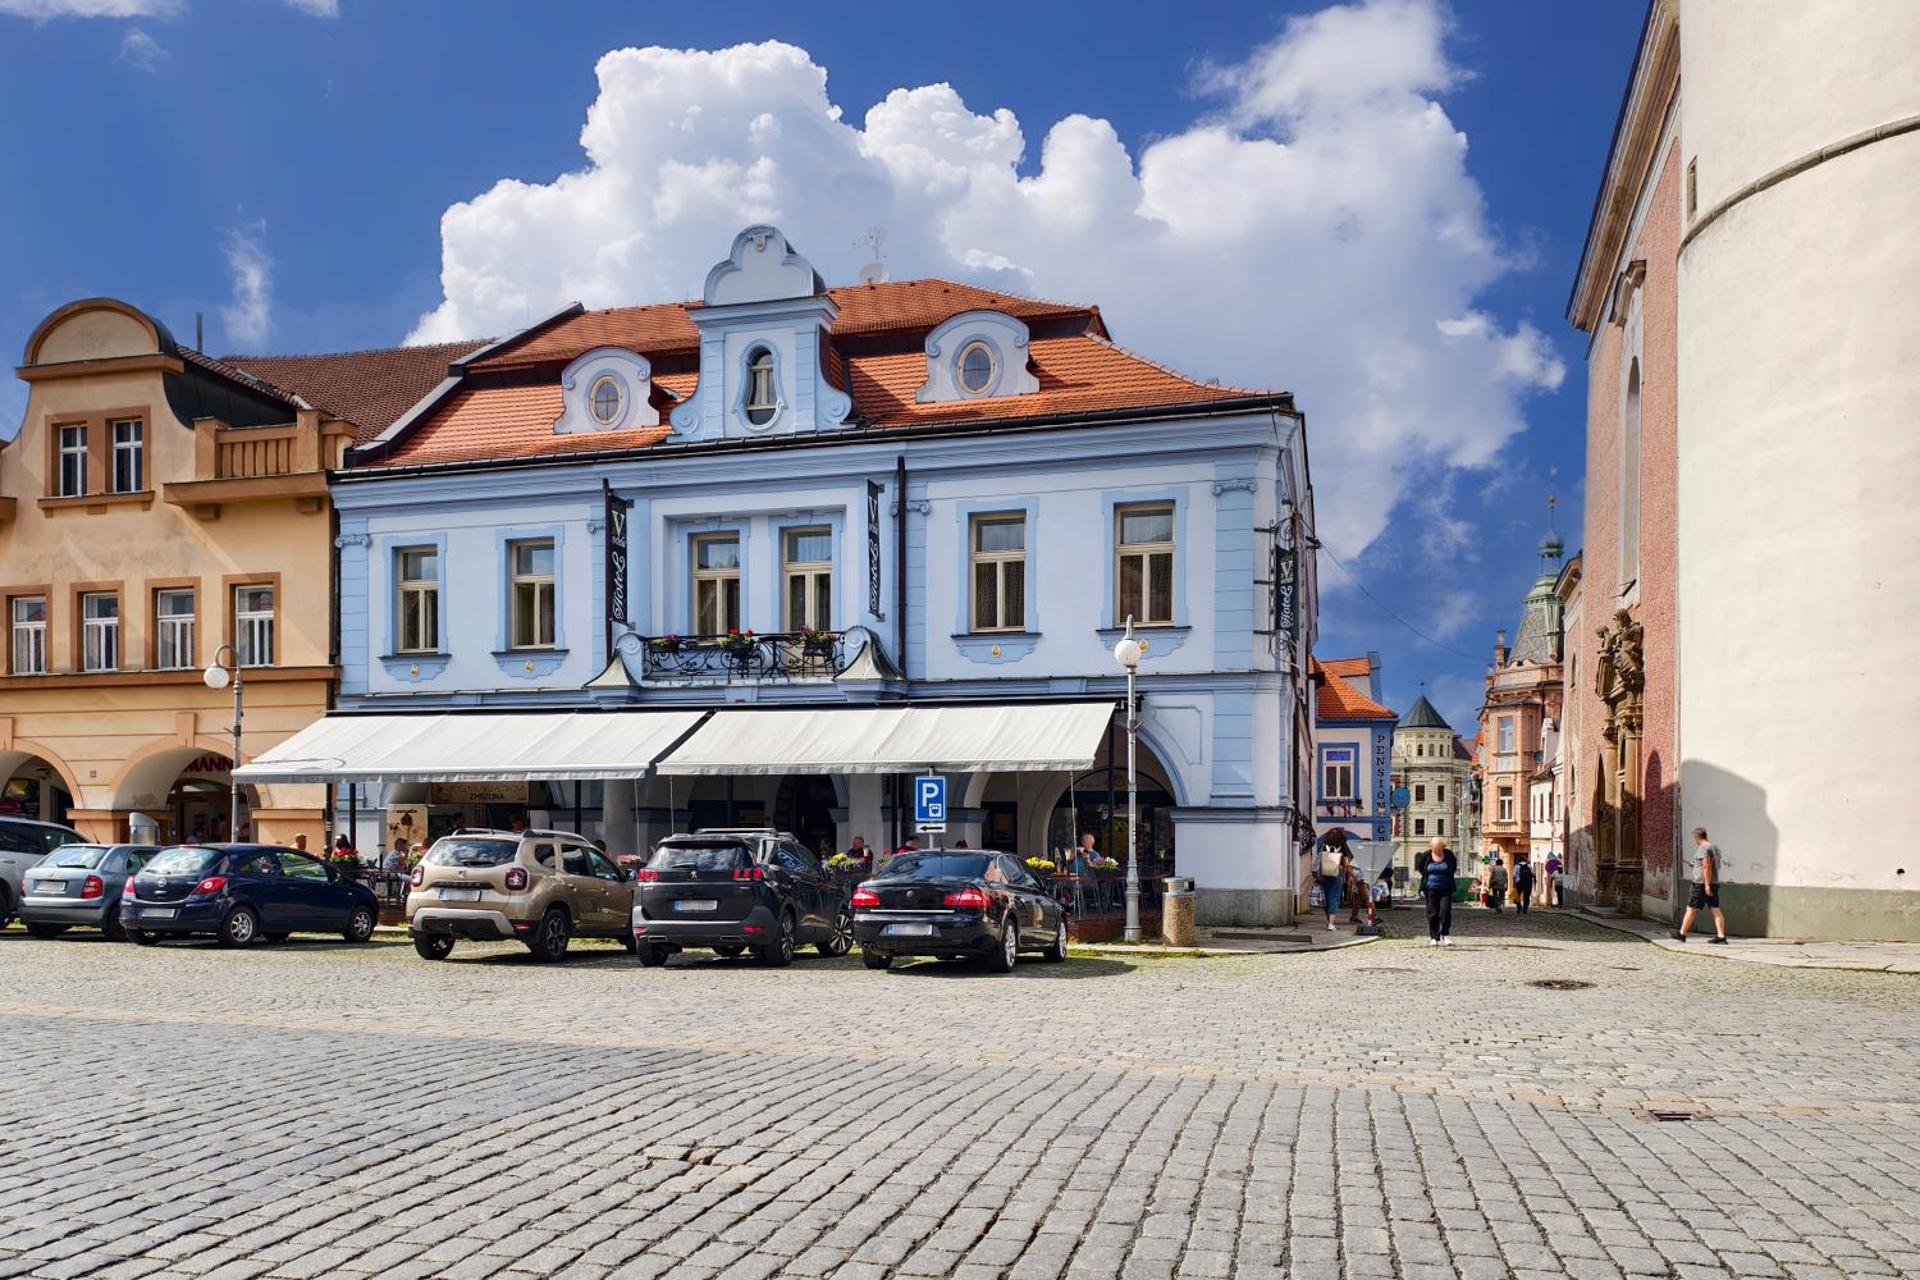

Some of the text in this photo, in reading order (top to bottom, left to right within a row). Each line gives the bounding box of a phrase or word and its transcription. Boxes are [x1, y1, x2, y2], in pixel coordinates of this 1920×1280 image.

[611, 551, 626, 620] Hotel
[1280, 585, 1293, 629] Hotel
[922, 783, 939, 807] P
